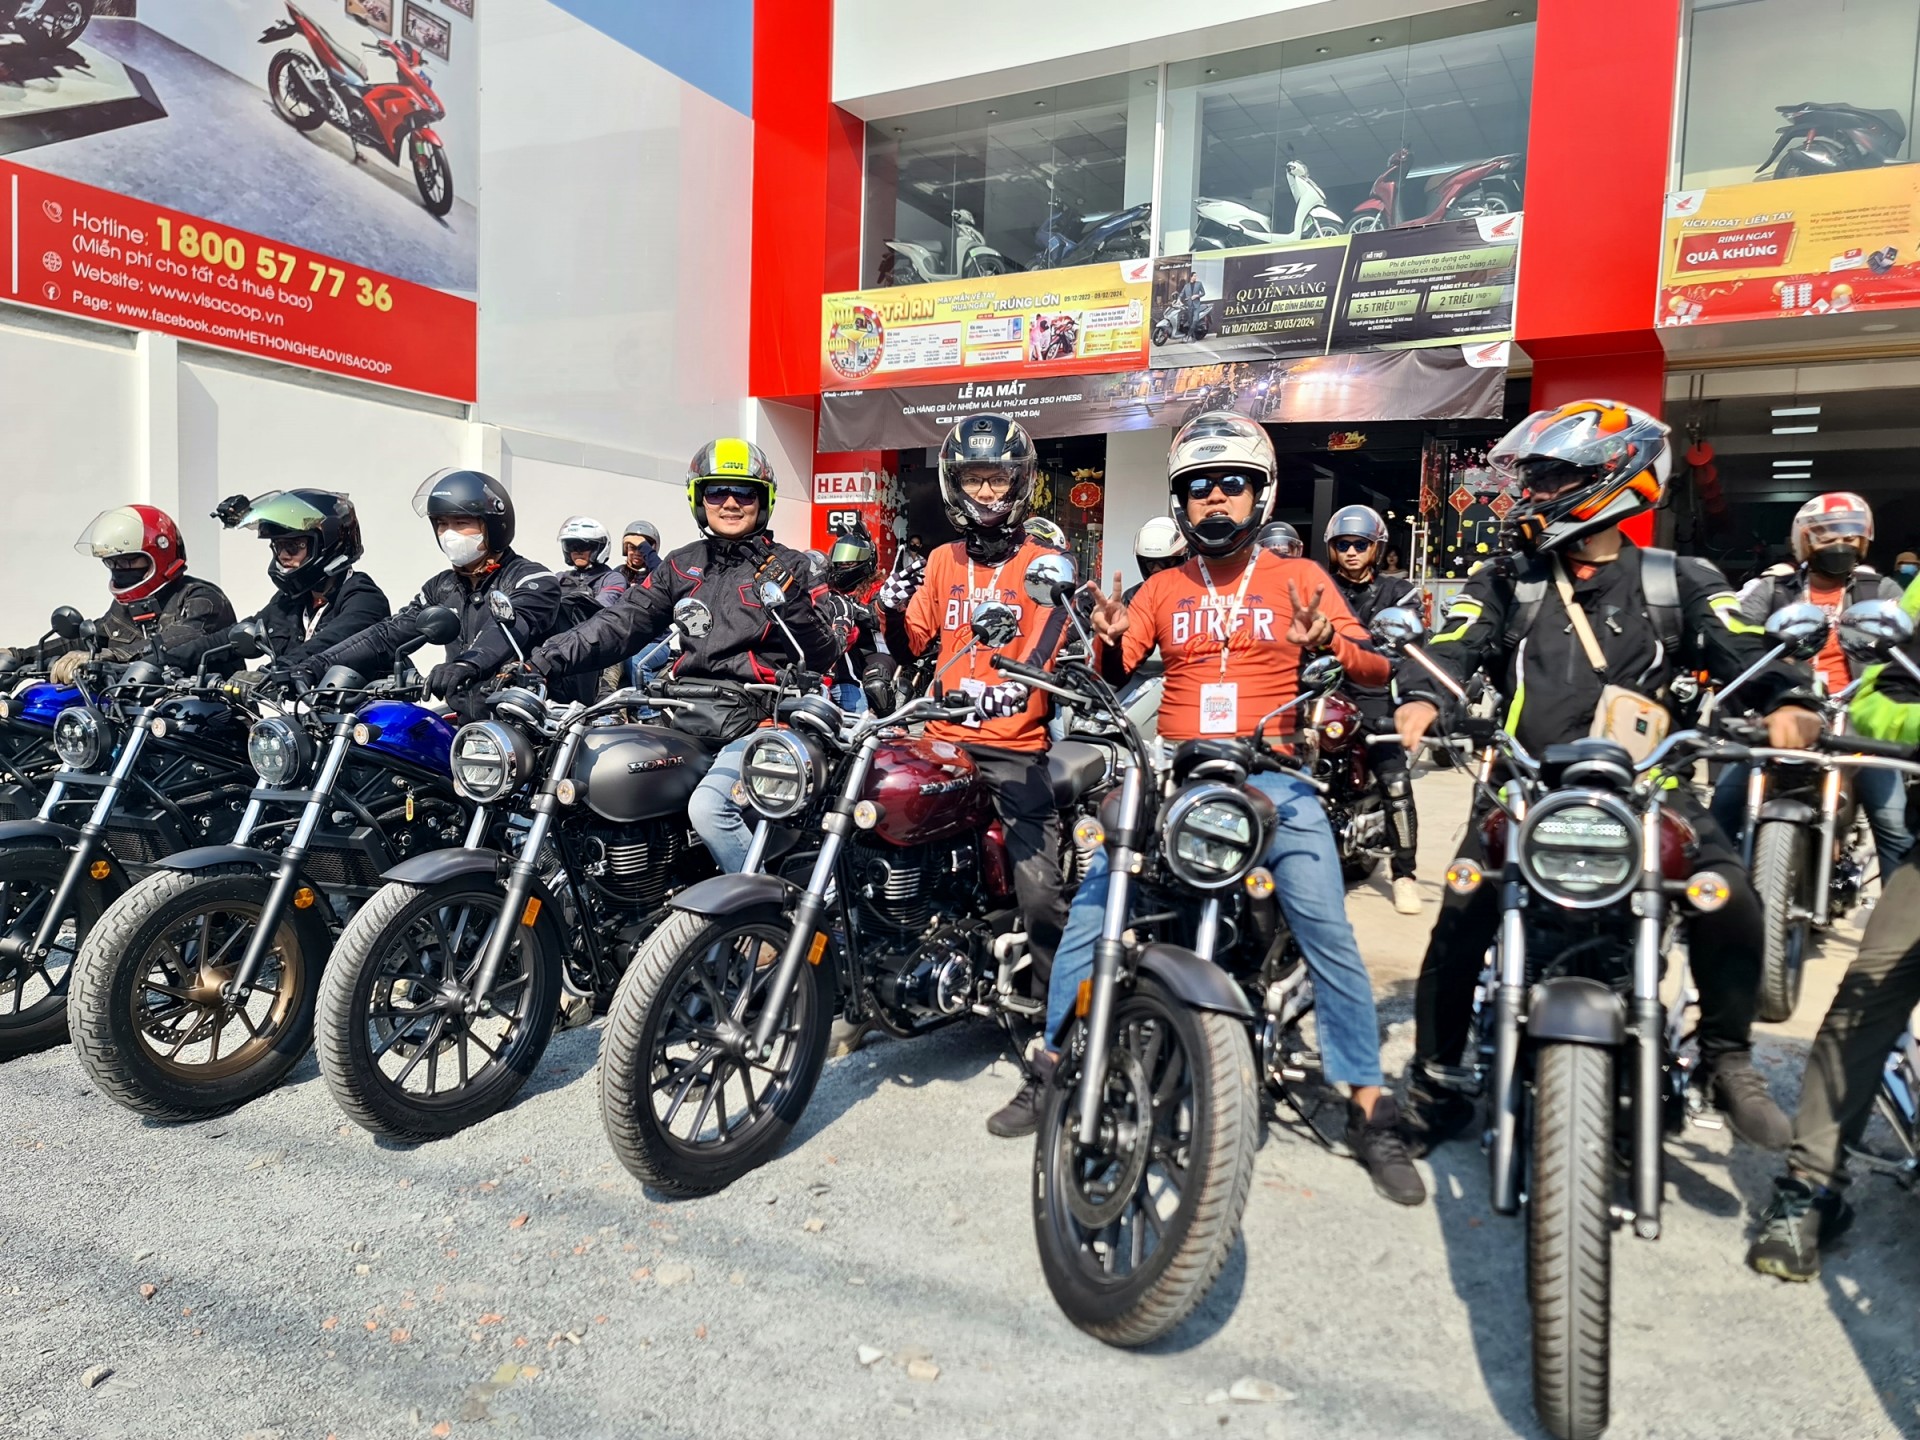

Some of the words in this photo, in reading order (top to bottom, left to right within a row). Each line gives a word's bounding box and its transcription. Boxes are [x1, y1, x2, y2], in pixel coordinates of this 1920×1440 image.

[1772, 210, 1793, 221] TAY
[1717, 234, 1744, 244] RINH
[1745, 230, 1775, 241] NGAY
[73, 207, 149, 247] Hotline:
[156, 216, 246, 271] 1800
[255, 246, 297, 284] 57
[308, 260, 346, 298] 77
[355, 276, 394, 312] 36
[1685, 248, 1720, 265] QUÀ
[1722, 243, 1778, 260] KHỦNG
[72, 233, 121, 261] (Miễn
[125, 250, 154, 268] phí
[155, 257, 188, 277] cho
[191, 264, 214, 283] tất
[217, 273, 239, 290] cả
[241, 277, 276, 300] thuê
[278, 287, 314, 312] bao)
[72, 259, 144, 292] Website:
[147, 282, 285, 327] www.visacoop.vn
[1236, 281, 1284, 303] QUYỀN
[1285, 280, 1327, 297] NĂNG
[1440, 296, 1446, 306] 2
[1448, 292, 1474, 307] TRIỆU
[951, 304, 968, 312] MUA
[992, 296, 1033, 312] TRÚNG
[1250, 299, 1271, 313] LỐI
[1315, 299, 1325, 308] A2
[1356, 304, 1369, 314] 3,5
[1371, 299, 1396, 314] TRIỆU
[72, 289, 113, 311] Page:
[115, 301, 393, 375] www.facebook.com/HETHONGHEADVISACOOP
[1222, 324, 1231, 335] Từ
[1231, 321, 1268, 333] 10/11/2023
[1273, 316, 1315, 330] 31/03/2024
[957, 383, 974, 400] LỄ
[975, 386, 994, 398] RA
[995, 380, 1026, 397] MẮT
[902, 404, 917, 415] CỬA
[916, 403, 936, 413] HÀNG
[936, 404, 946, 412] CB
[946, 402, 957, 412] ỦY
[957, 400, 980, 412] NHIỆM
[980, 399, 990, 409] VÀ
[990, 399, 1003, 408] LÁI
[1017, 398, 1029, 406] XE
[1028, 397, 1040, 406] CB
[1039, 396, 1055, 404] 350
[1055, 393, 1083, 403] H'NESS
[935, 416, 953, 424] CB
[1014, 410, 1029, 418] THỜI
[1029, 409, 1041, 419] ĐẠI
[723, 461, 744, 470] GIVI
[817, 477, 872, 493] HEAD
[829, 511, 857, 526] CB
[627, 755, 686, 774] HONDA
[918, 775, 971, 796] HONDA
